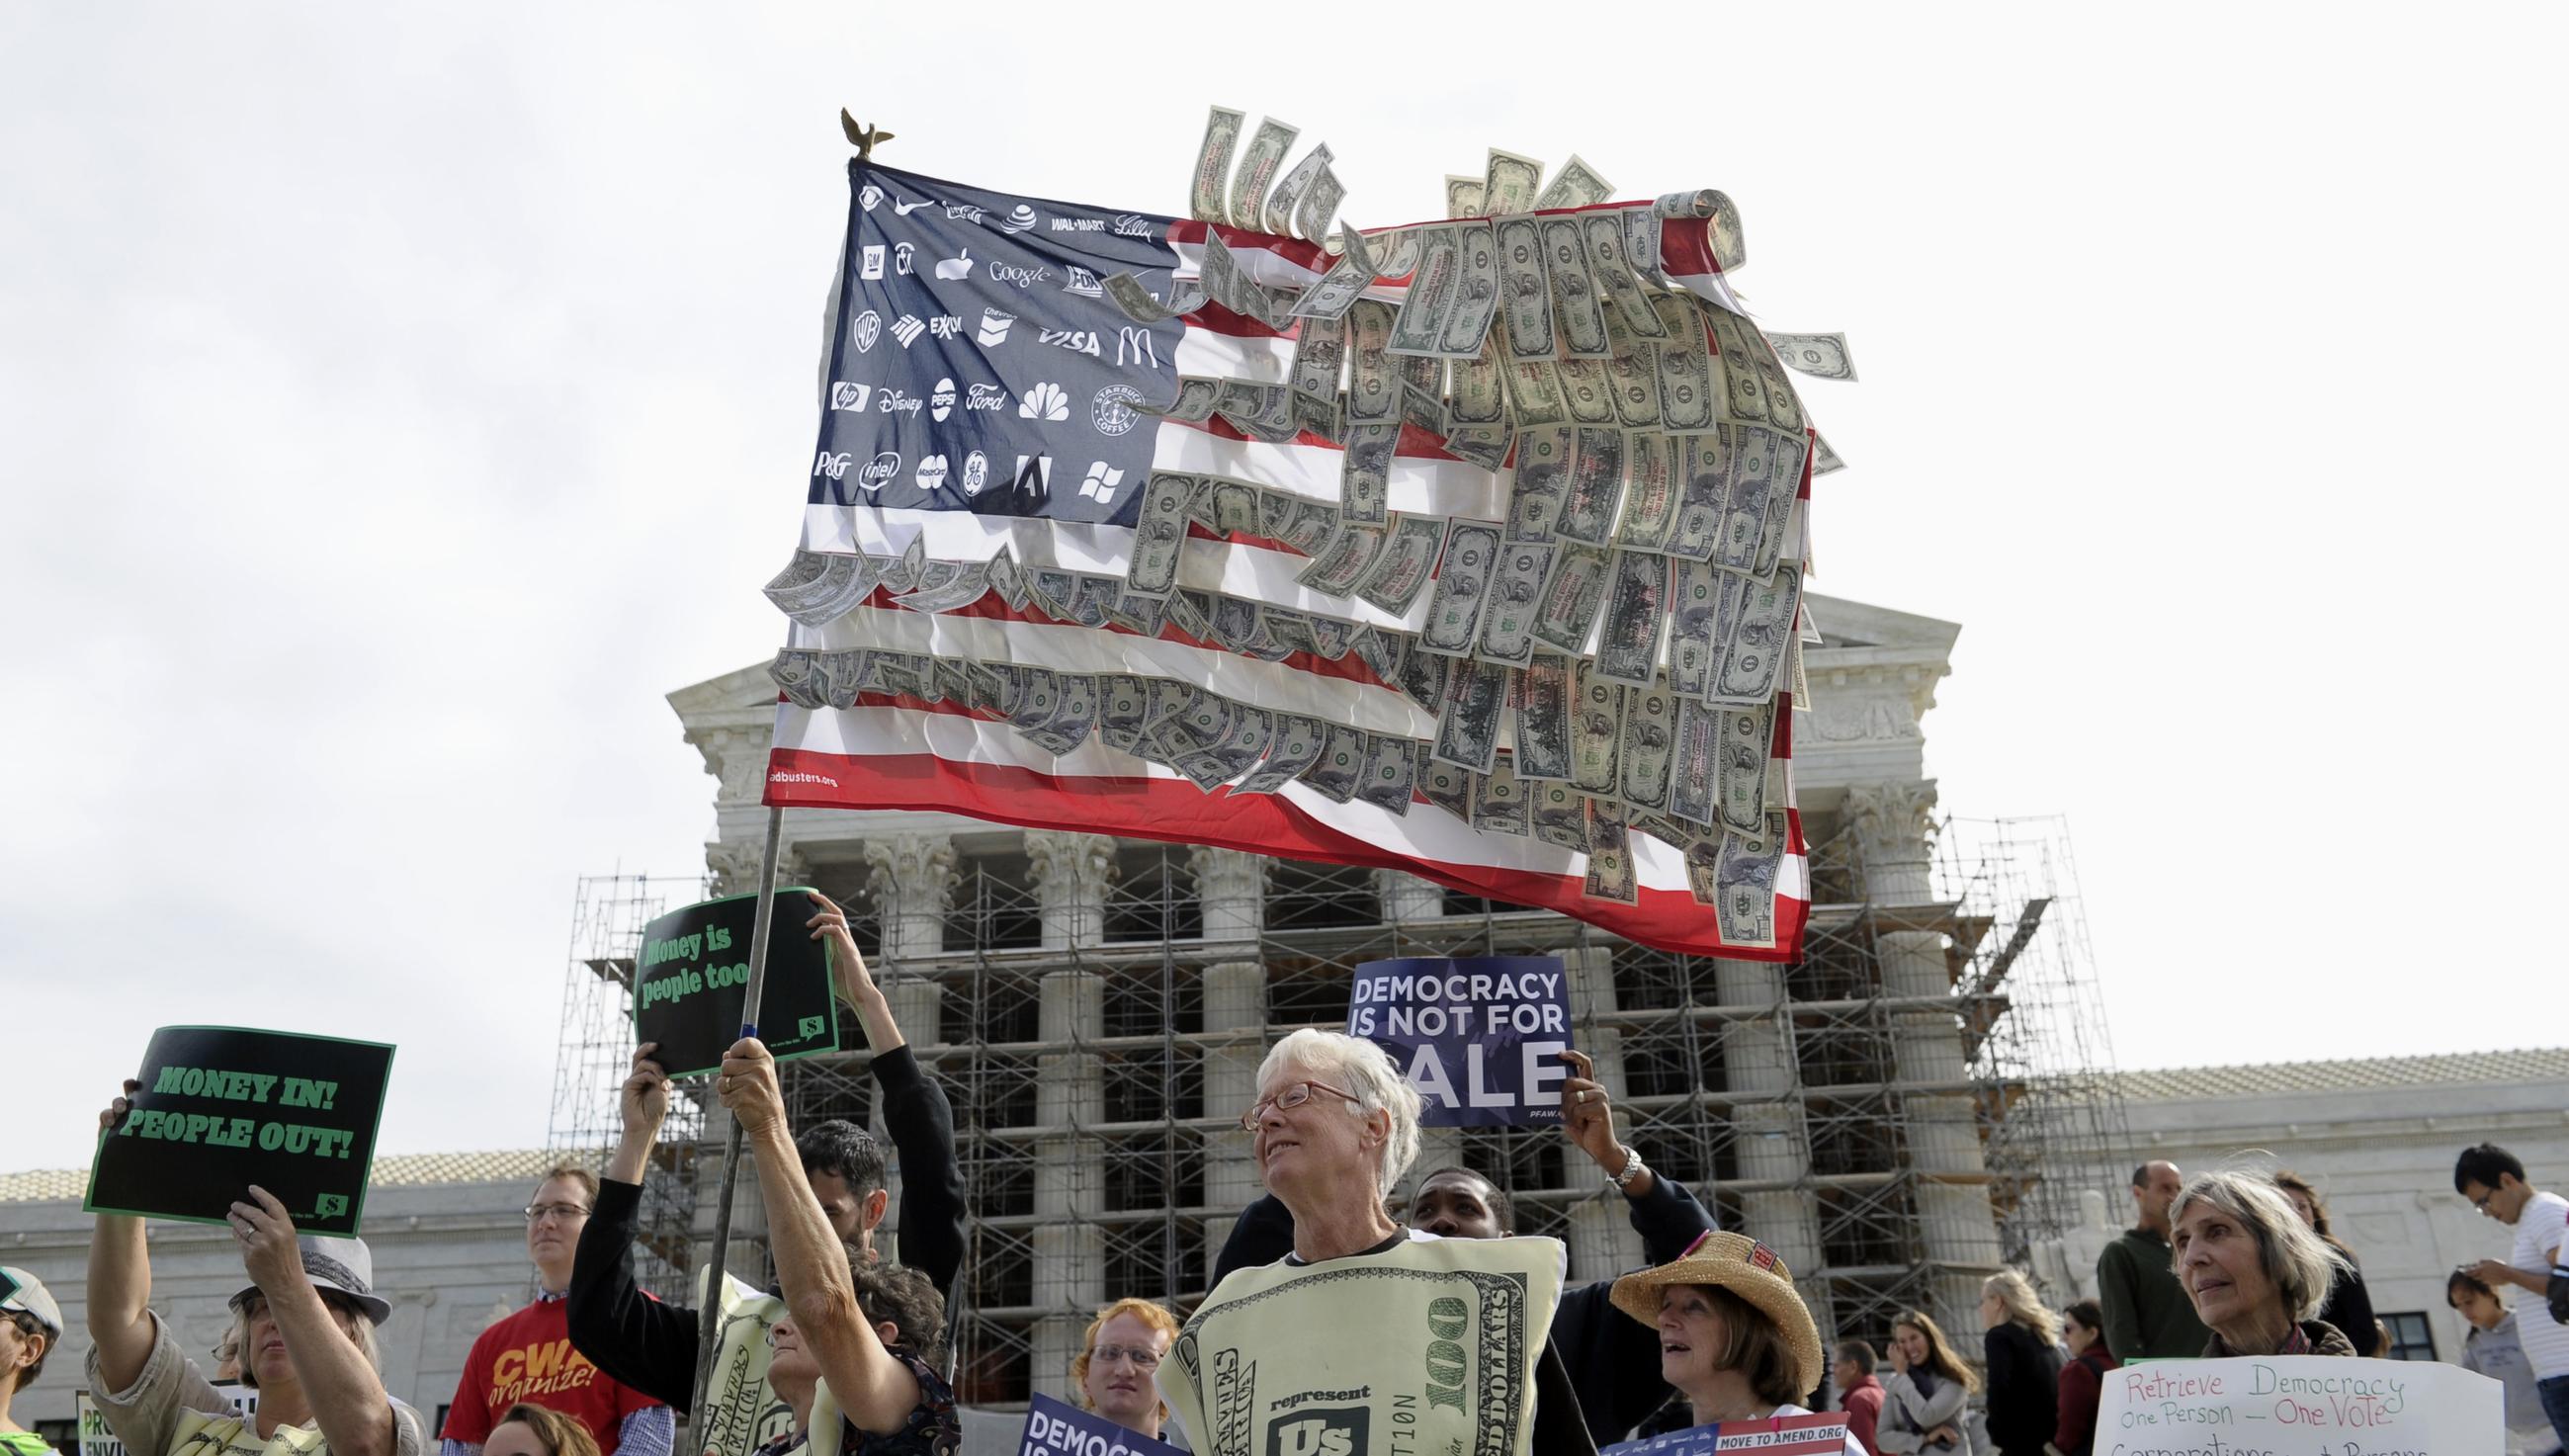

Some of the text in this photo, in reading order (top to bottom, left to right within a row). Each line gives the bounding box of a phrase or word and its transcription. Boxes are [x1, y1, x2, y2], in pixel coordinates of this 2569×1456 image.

[1114, 214, 1153, 243] Lilly
[989, 261, 1051, 288] Google
[857, 314, 877, 343] WB
[1038, 327, 1100, 356] VISA
[837, 383, 856, 410] hp
[931, 393, 957, 406] PEPSI
[966, 383, 1006, 411] Ford
[1096, 417, 1130, 433] COFFEE
[814, 451, 852, 480] P&G
[770, 772, 838, 788] adbusters.org
[644, 924, 731, 967] Money is
[642, 963, 750, 1009] people too
[1354, 973, 1560, 1004] DEMOCRACY
[1350, 1004, 1566, 1037] IS NOT FOR
[153, 1066, 338, 1110] MONEY IN!
[1406, 1041, 1567, 1108] ALE
[119, 1108, 354, 1159] PEOPLE OUT!
[1425, 1296, 1468, 1417] 100
[488, 1366, 597, 1408] organize!
[1270, 1385, 1371, 1412] represent
[2127, 1364, 2405, 1413] Retrieve Democracy
[2121, 1409, 2158, 1429] One
[2163, 1402, 2233, 1426] Person
[2275, 1398, 2327, 1426] One
[1720, 1436, 1752, 1449] MOVE
[1755, 1434, 1771, 1446] TO
[1772, 1426, 1842, 1444] AMEND.ORG
